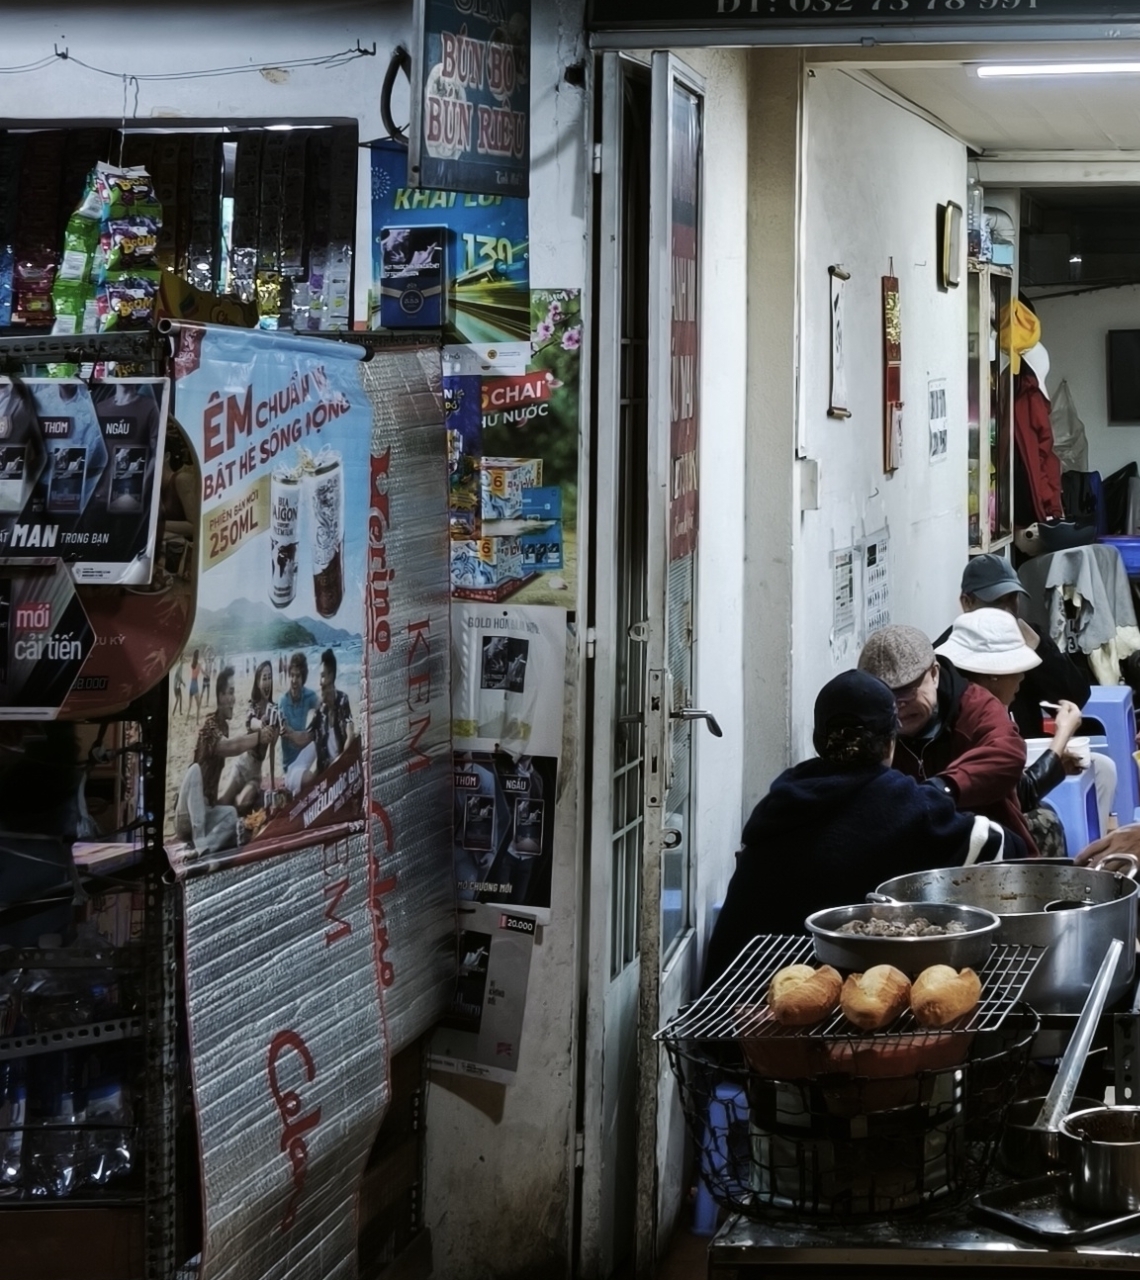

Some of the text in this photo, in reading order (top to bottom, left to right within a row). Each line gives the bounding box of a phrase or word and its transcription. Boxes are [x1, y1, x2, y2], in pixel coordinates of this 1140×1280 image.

[441, 22, 486, 91] BÚN
[427, 84, 526, 160] BÚN RIÊU
[203, 384, 253, 464] ÊM
[502, 403, 549, 425] NƯỚC
[203, 459, 237, 502] BẬT
[239, 443, 257, 480] HÈ
[259, 418, 302, 465] SỐNG
[273, 505, 299, 521] AIGON
[10, 524, 60, 548] MAN
[60, 531, 90, 545] TRONG
[91, 531, 110, 546] BẠN
[209, 512, 259, 560] 250ML
[16, 603, 51, 628] mới
[14, 631, 82, 660] cải tiến
[507, 918, 534, 932] 20.000
